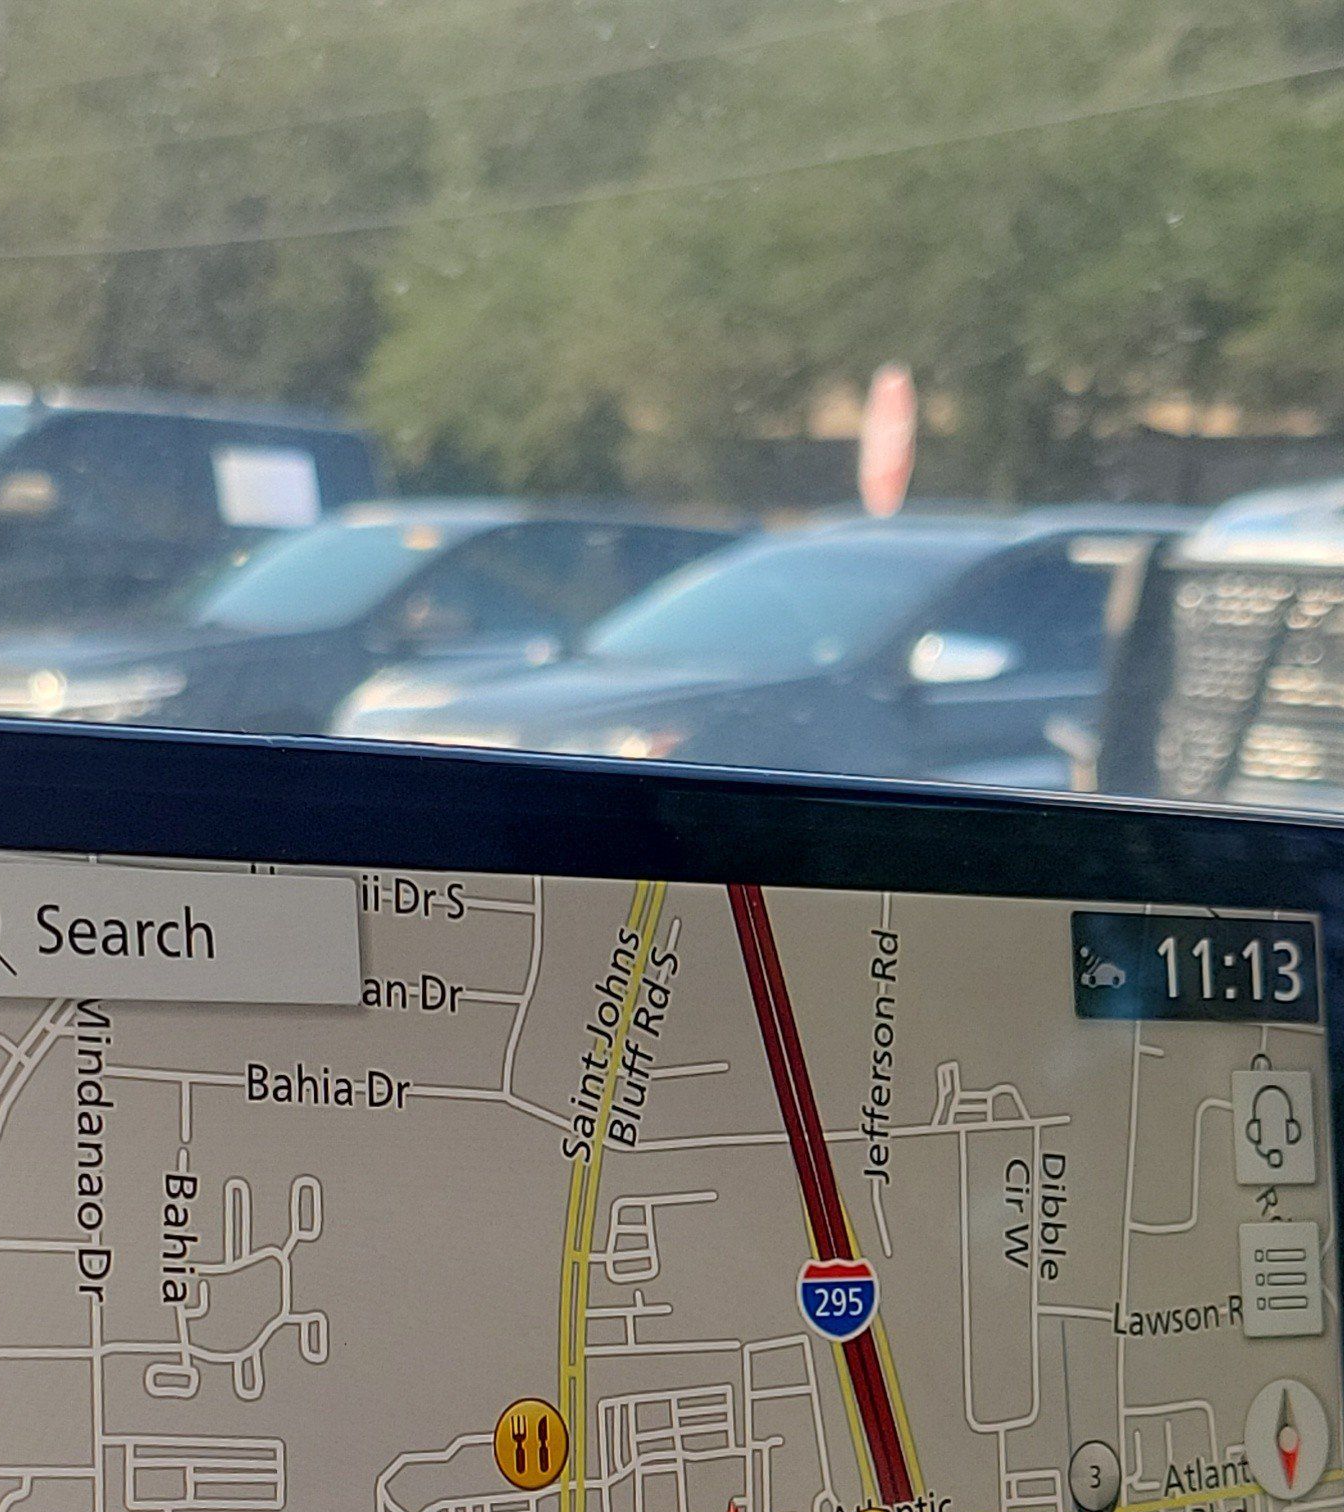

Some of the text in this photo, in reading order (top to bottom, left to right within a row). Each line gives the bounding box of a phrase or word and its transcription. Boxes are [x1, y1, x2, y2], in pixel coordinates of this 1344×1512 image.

[394, 877, 436, 916] Dr
[447, 883, 464, 919] S
[36, 904, 215, 960] Search
[421, 974, 463, 1012] Dr
[1158, 937, 1302, 1002] 11:13
[563, 928, 640, 1162] Saint Johns
[608, 947, 679, 1147] Bluff Rd S
[862, 930, 899, 1184] Jefferson Rd
[246, 1064, 411, 1107] Bahia Dr
[76, 998, 114, 1302] Mindanao Dr
[163, 1175, 198, 1303] Bahia
[1004, 1160, 1030, 1268] Cir W
[1041, 1153, 1067, 1281] Dibble
[814, 1288, 863, 1318] 295
[1114, 1295, 1244, 1335] Lawson R
[1089, 1466, 1101, 1489] 3
[1164, 1456, 1256, 1497] Atlant
